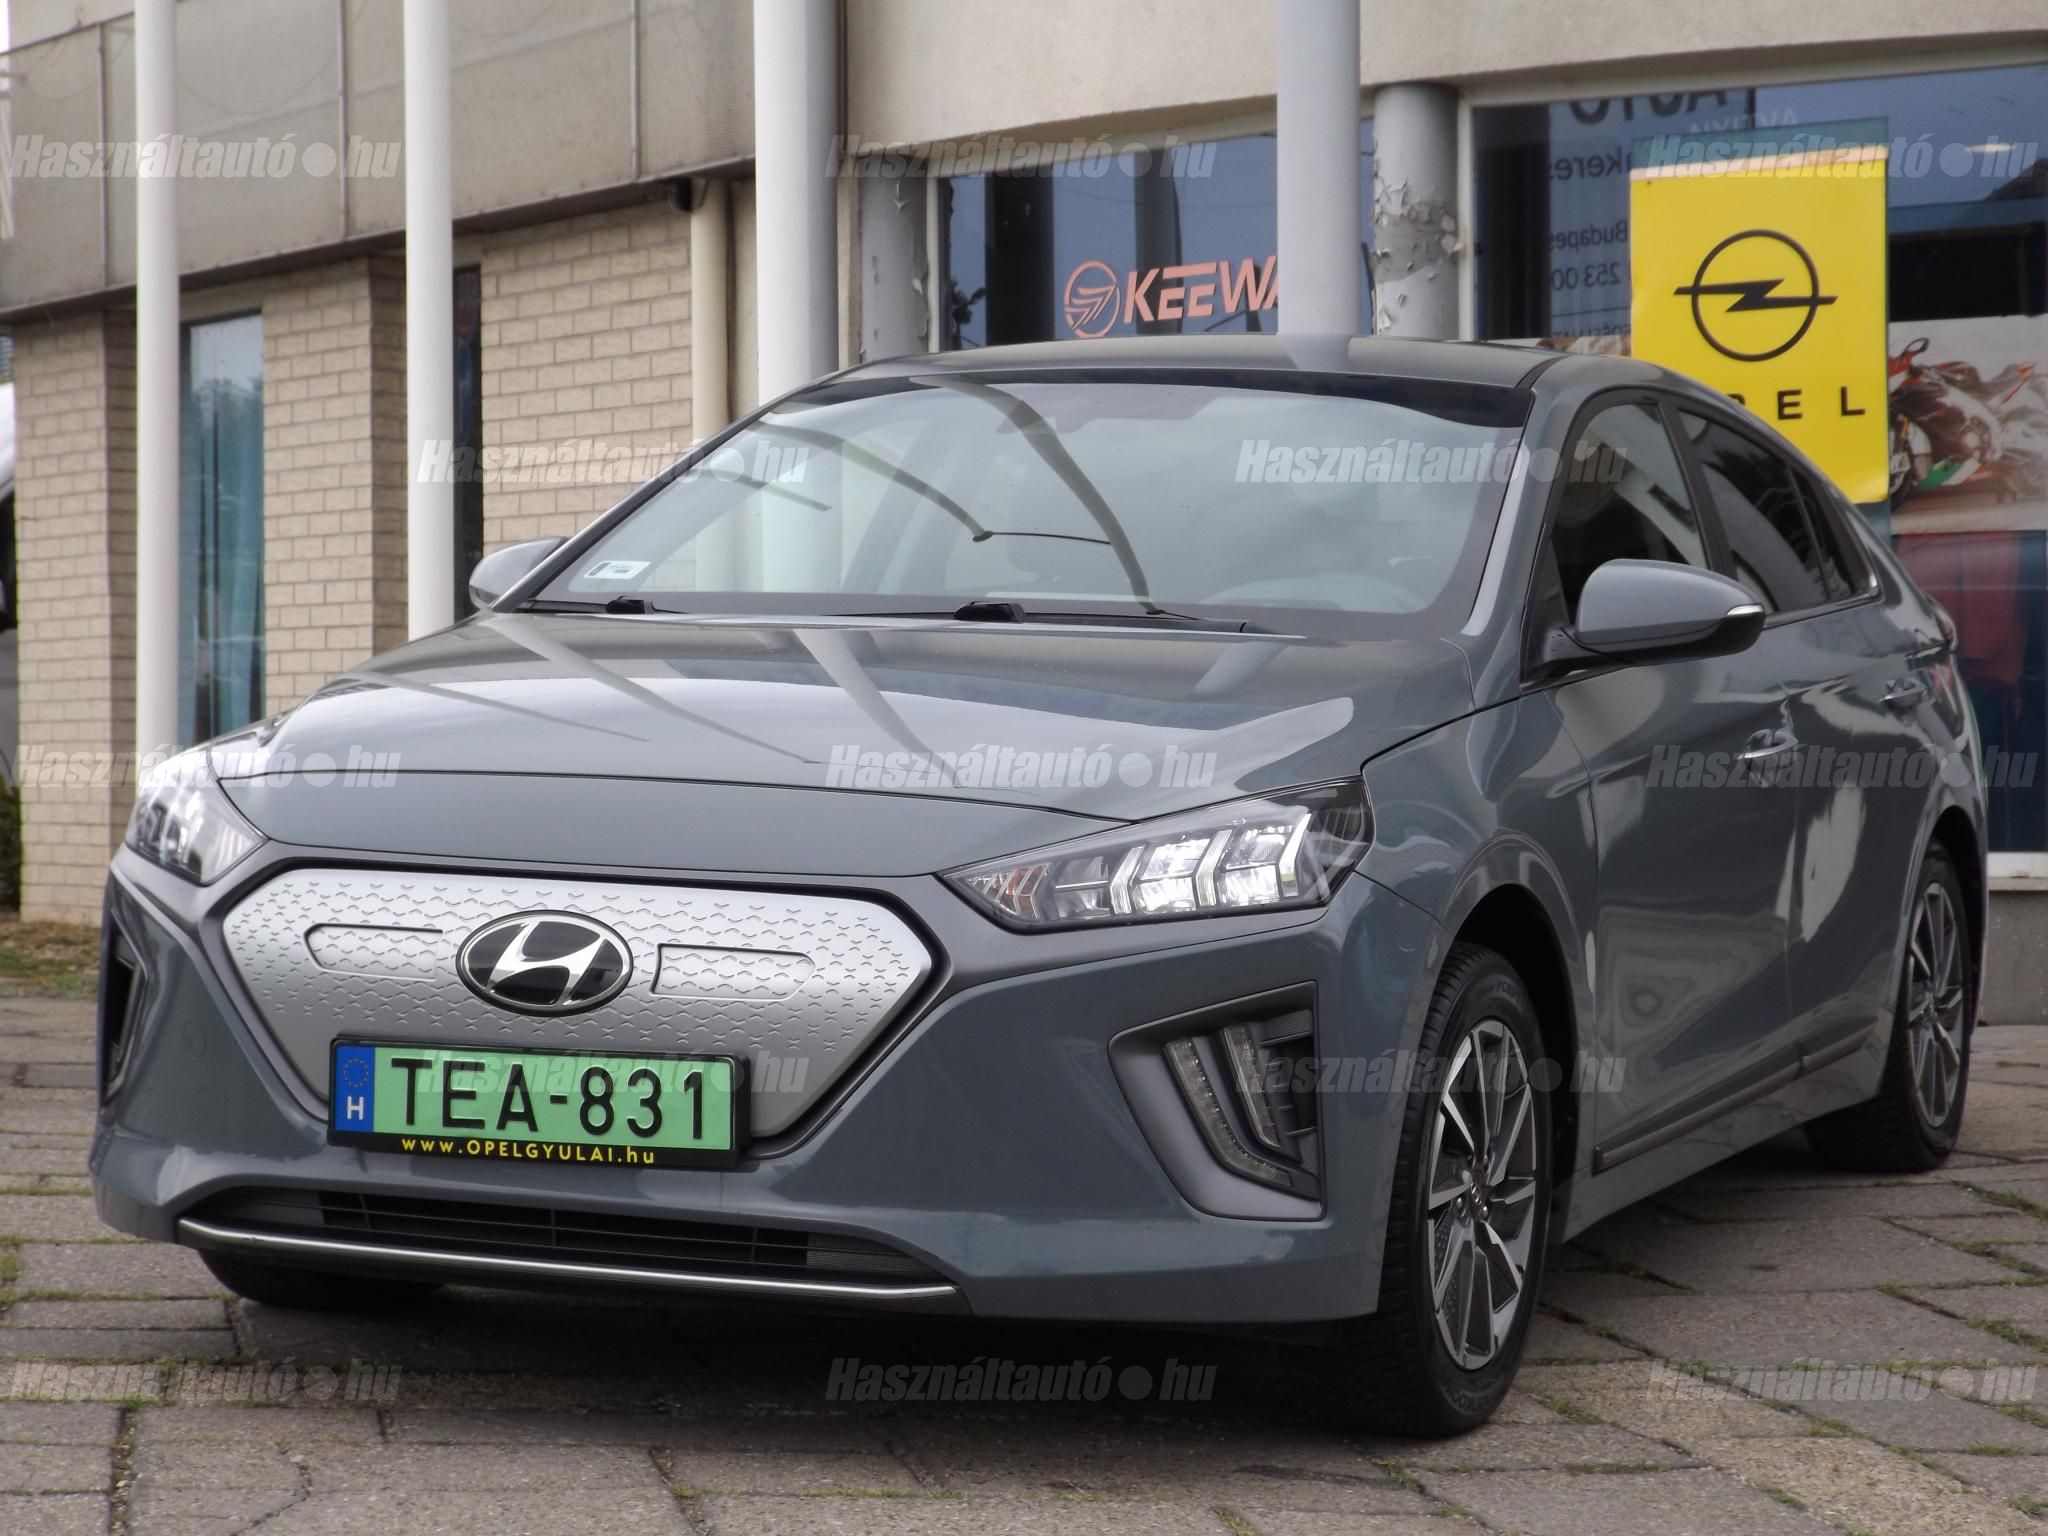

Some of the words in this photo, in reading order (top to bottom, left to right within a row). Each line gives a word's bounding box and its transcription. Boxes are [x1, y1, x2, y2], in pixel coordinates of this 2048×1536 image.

[346, 1095, 364, 1121] H
[391, 1057, 703, 1140] TEA-831
[402, 1138, 655, 1164] www.OPELGYULAI.hu
